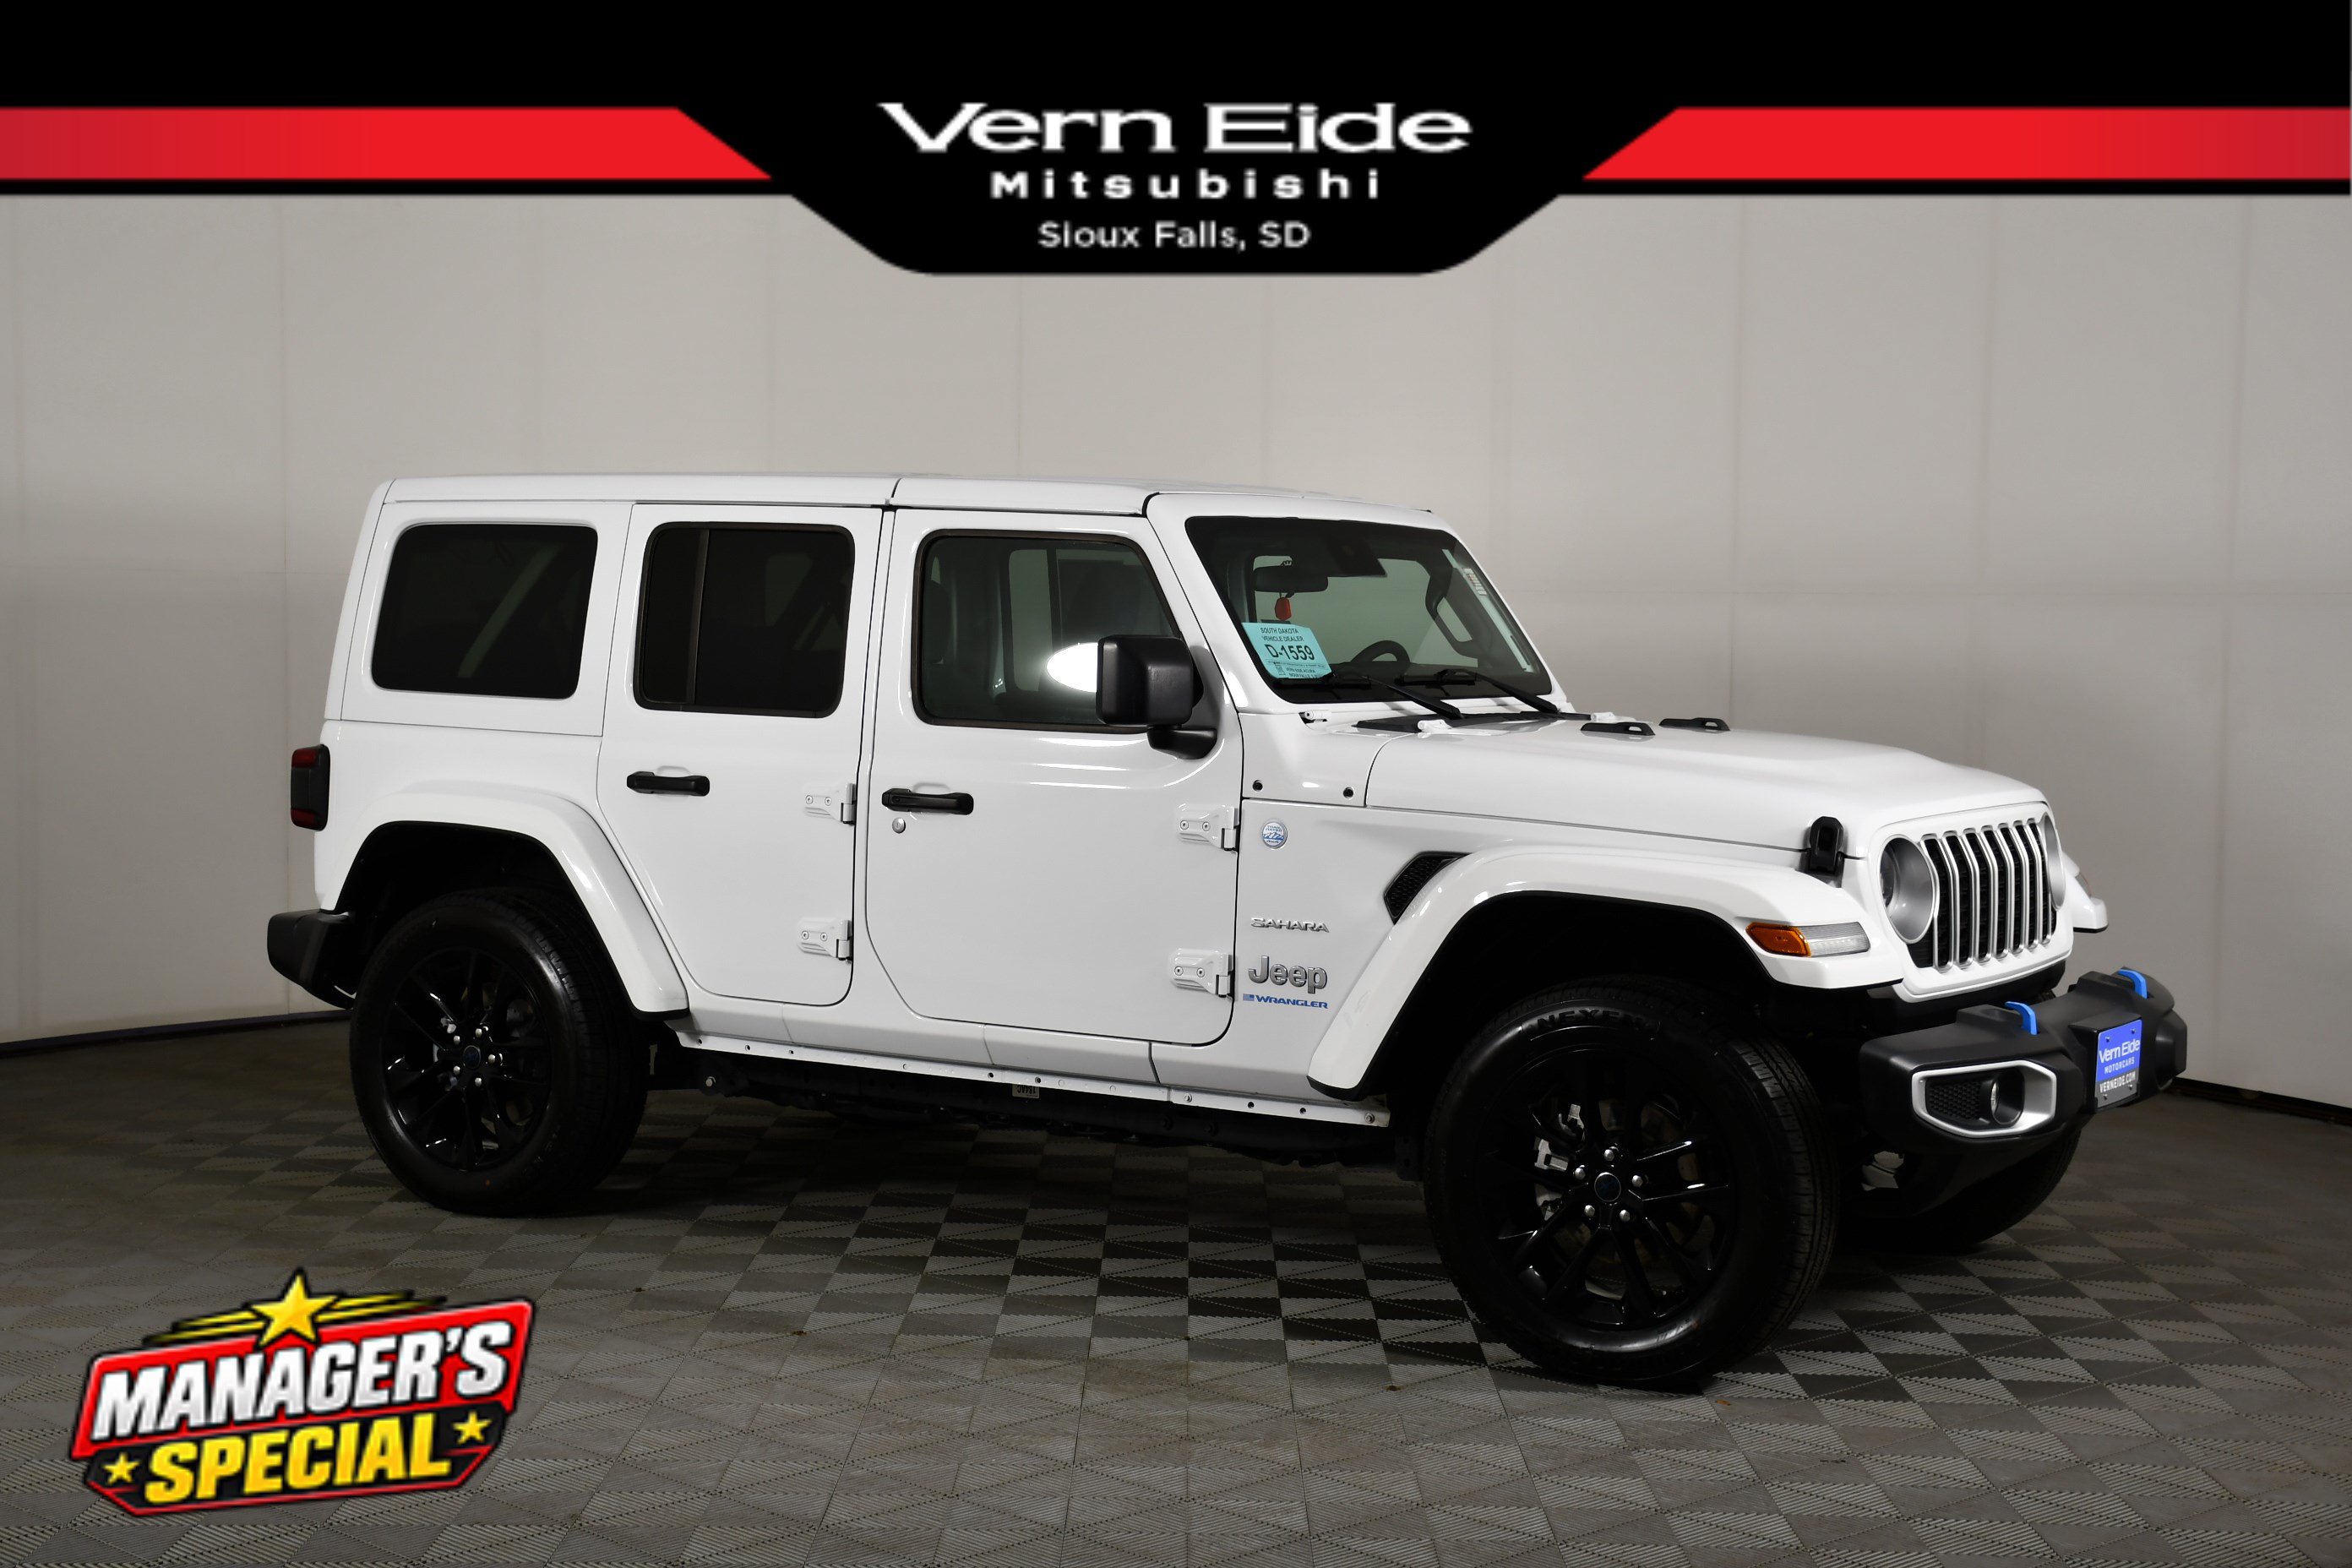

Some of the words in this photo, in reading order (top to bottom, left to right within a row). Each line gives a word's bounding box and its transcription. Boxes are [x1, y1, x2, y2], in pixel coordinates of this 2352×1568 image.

[1265, 644, 1315, 661] D-1559
[1250, 917, 1330, 933] SAHARA
[1248, 956, 1327, 994] Jeep
[1255, 995, 1328, 1010] WRANGLER
[2099, 1046, 2121, 1063] Vern
[2121, 1038, 2141, 1056] Eide
[2104, 1056, 2135, 1075] MOTORCARS
[2099, 1070, 2136, 1093] VERNEIDE.COM
